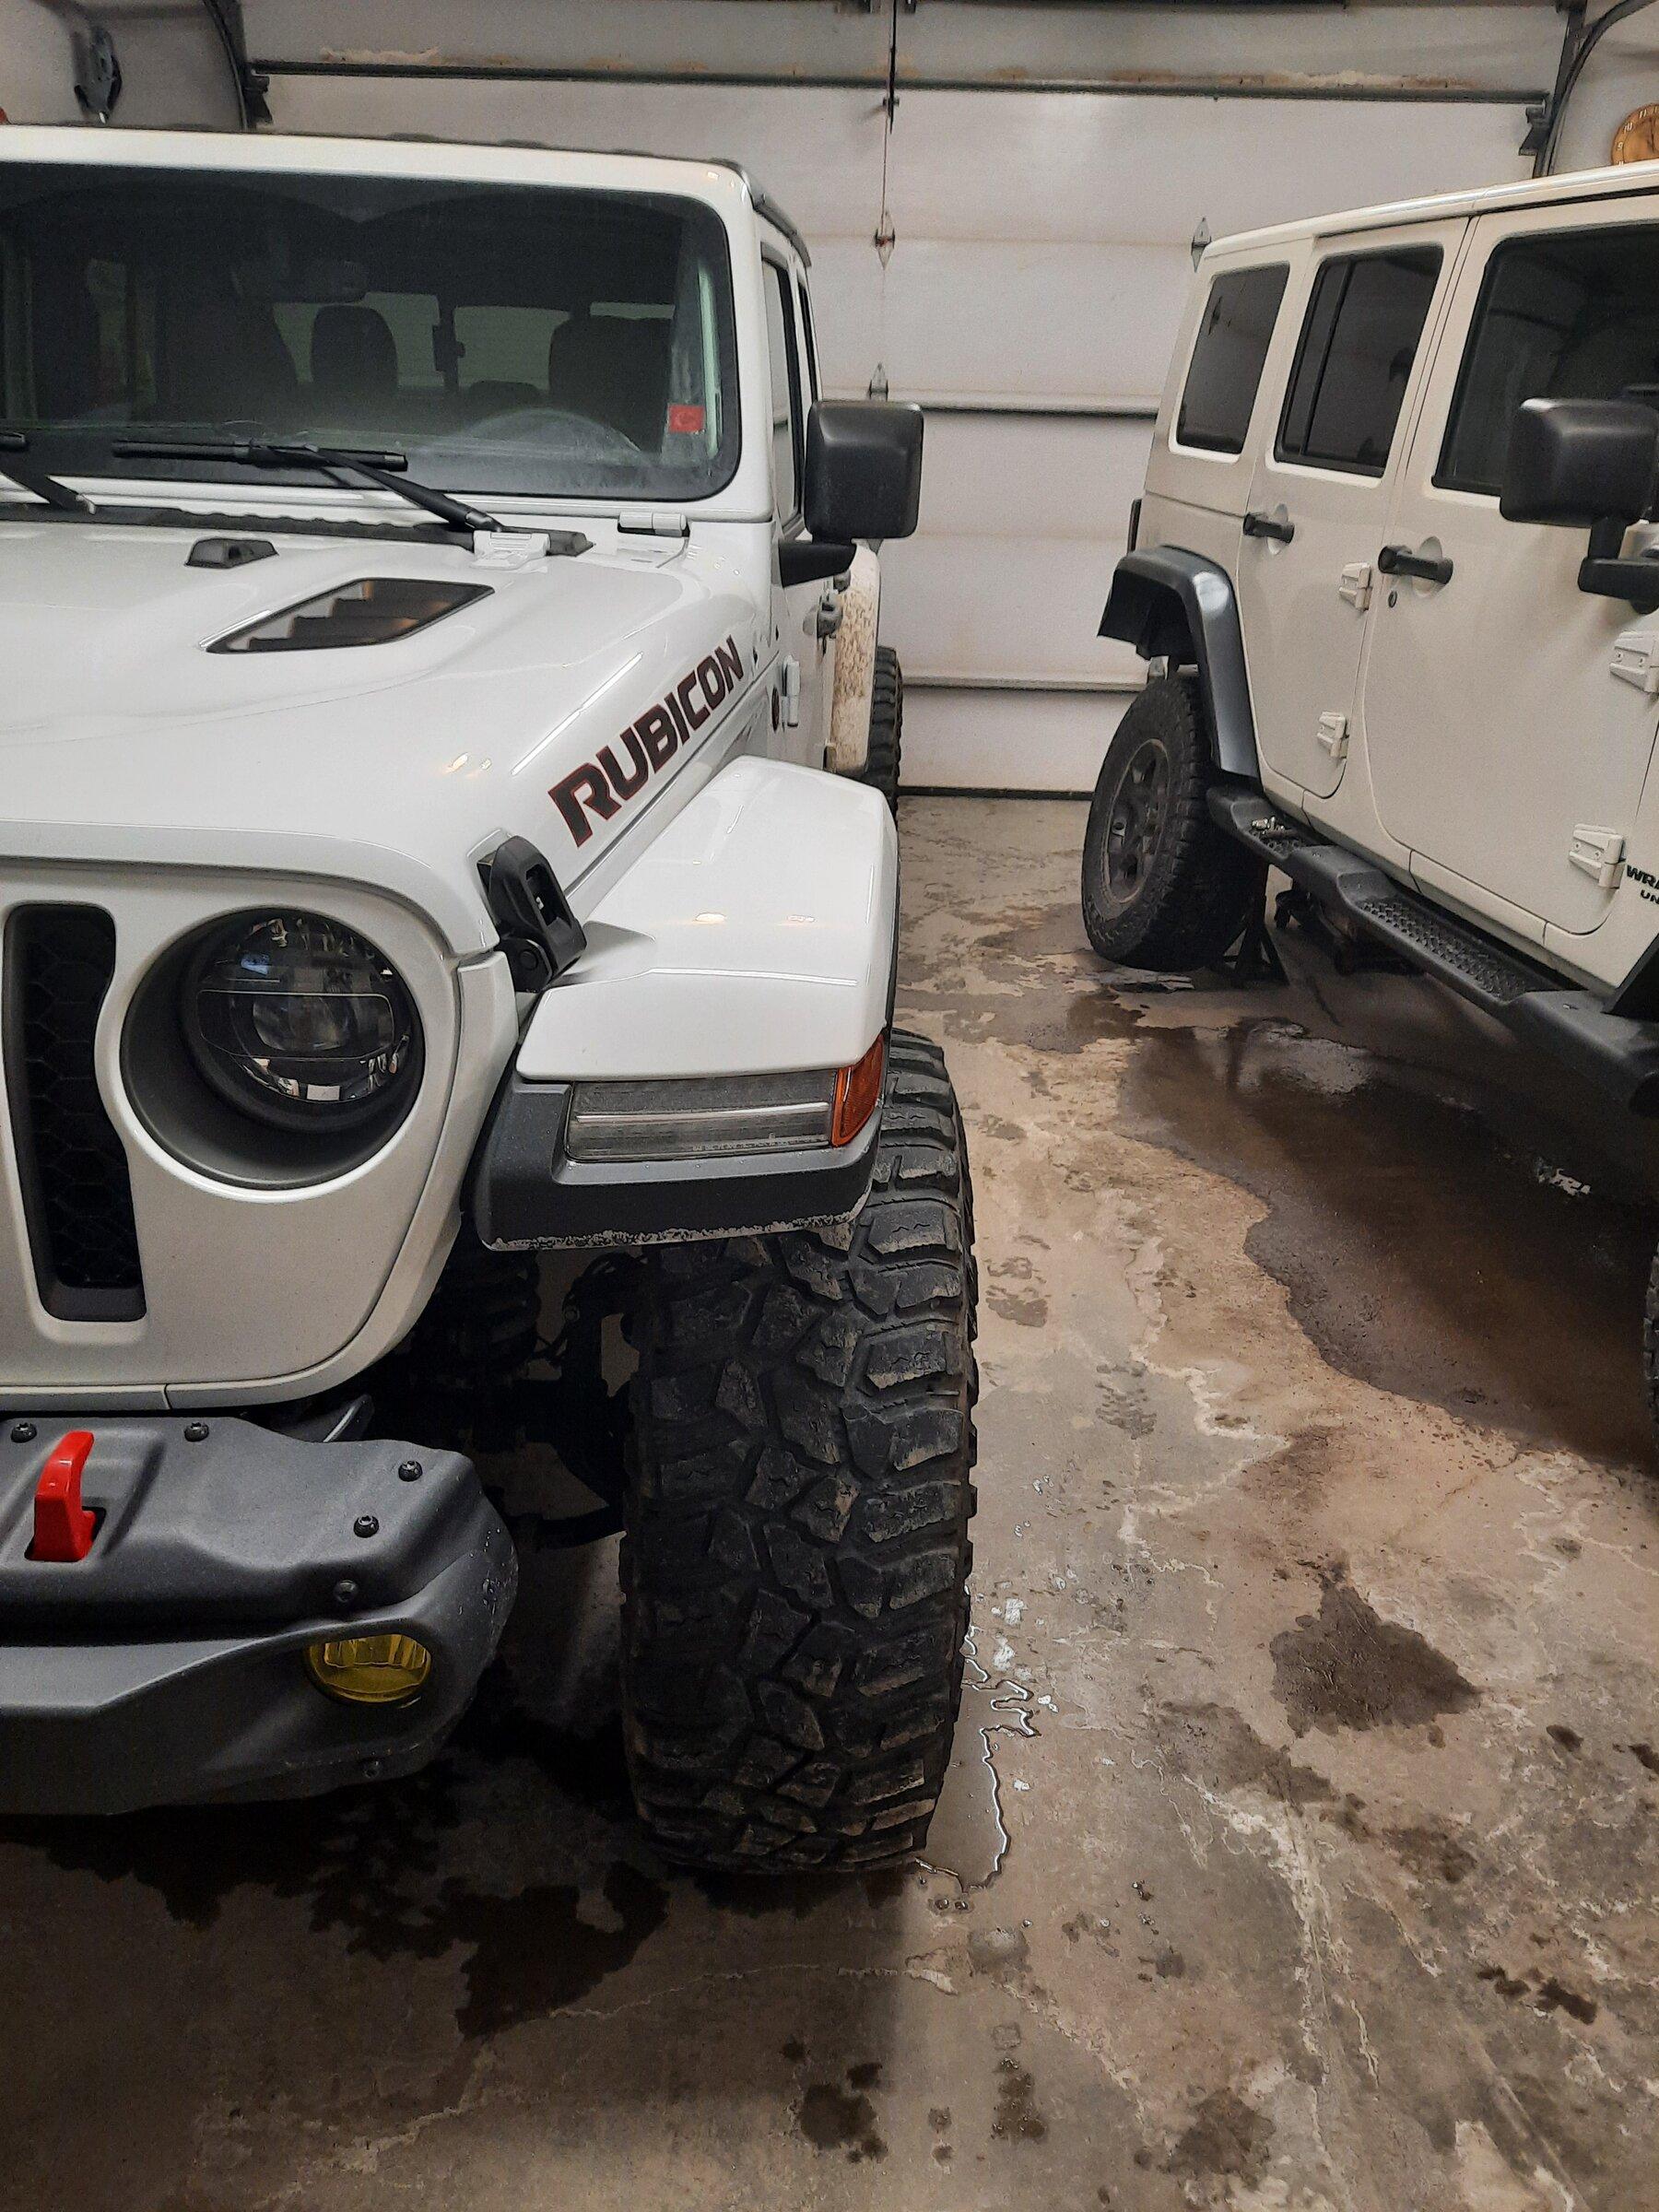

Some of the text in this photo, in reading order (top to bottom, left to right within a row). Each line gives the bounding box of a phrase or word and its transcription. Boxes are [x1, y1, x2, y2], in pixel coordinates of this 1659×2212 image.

[1639, 109, 1647, 119] 11
[1624, 123, 1633, 133] 10
[1618, 141, 1623, 150] 9
[547, 634, 745, 849] RUBICON
